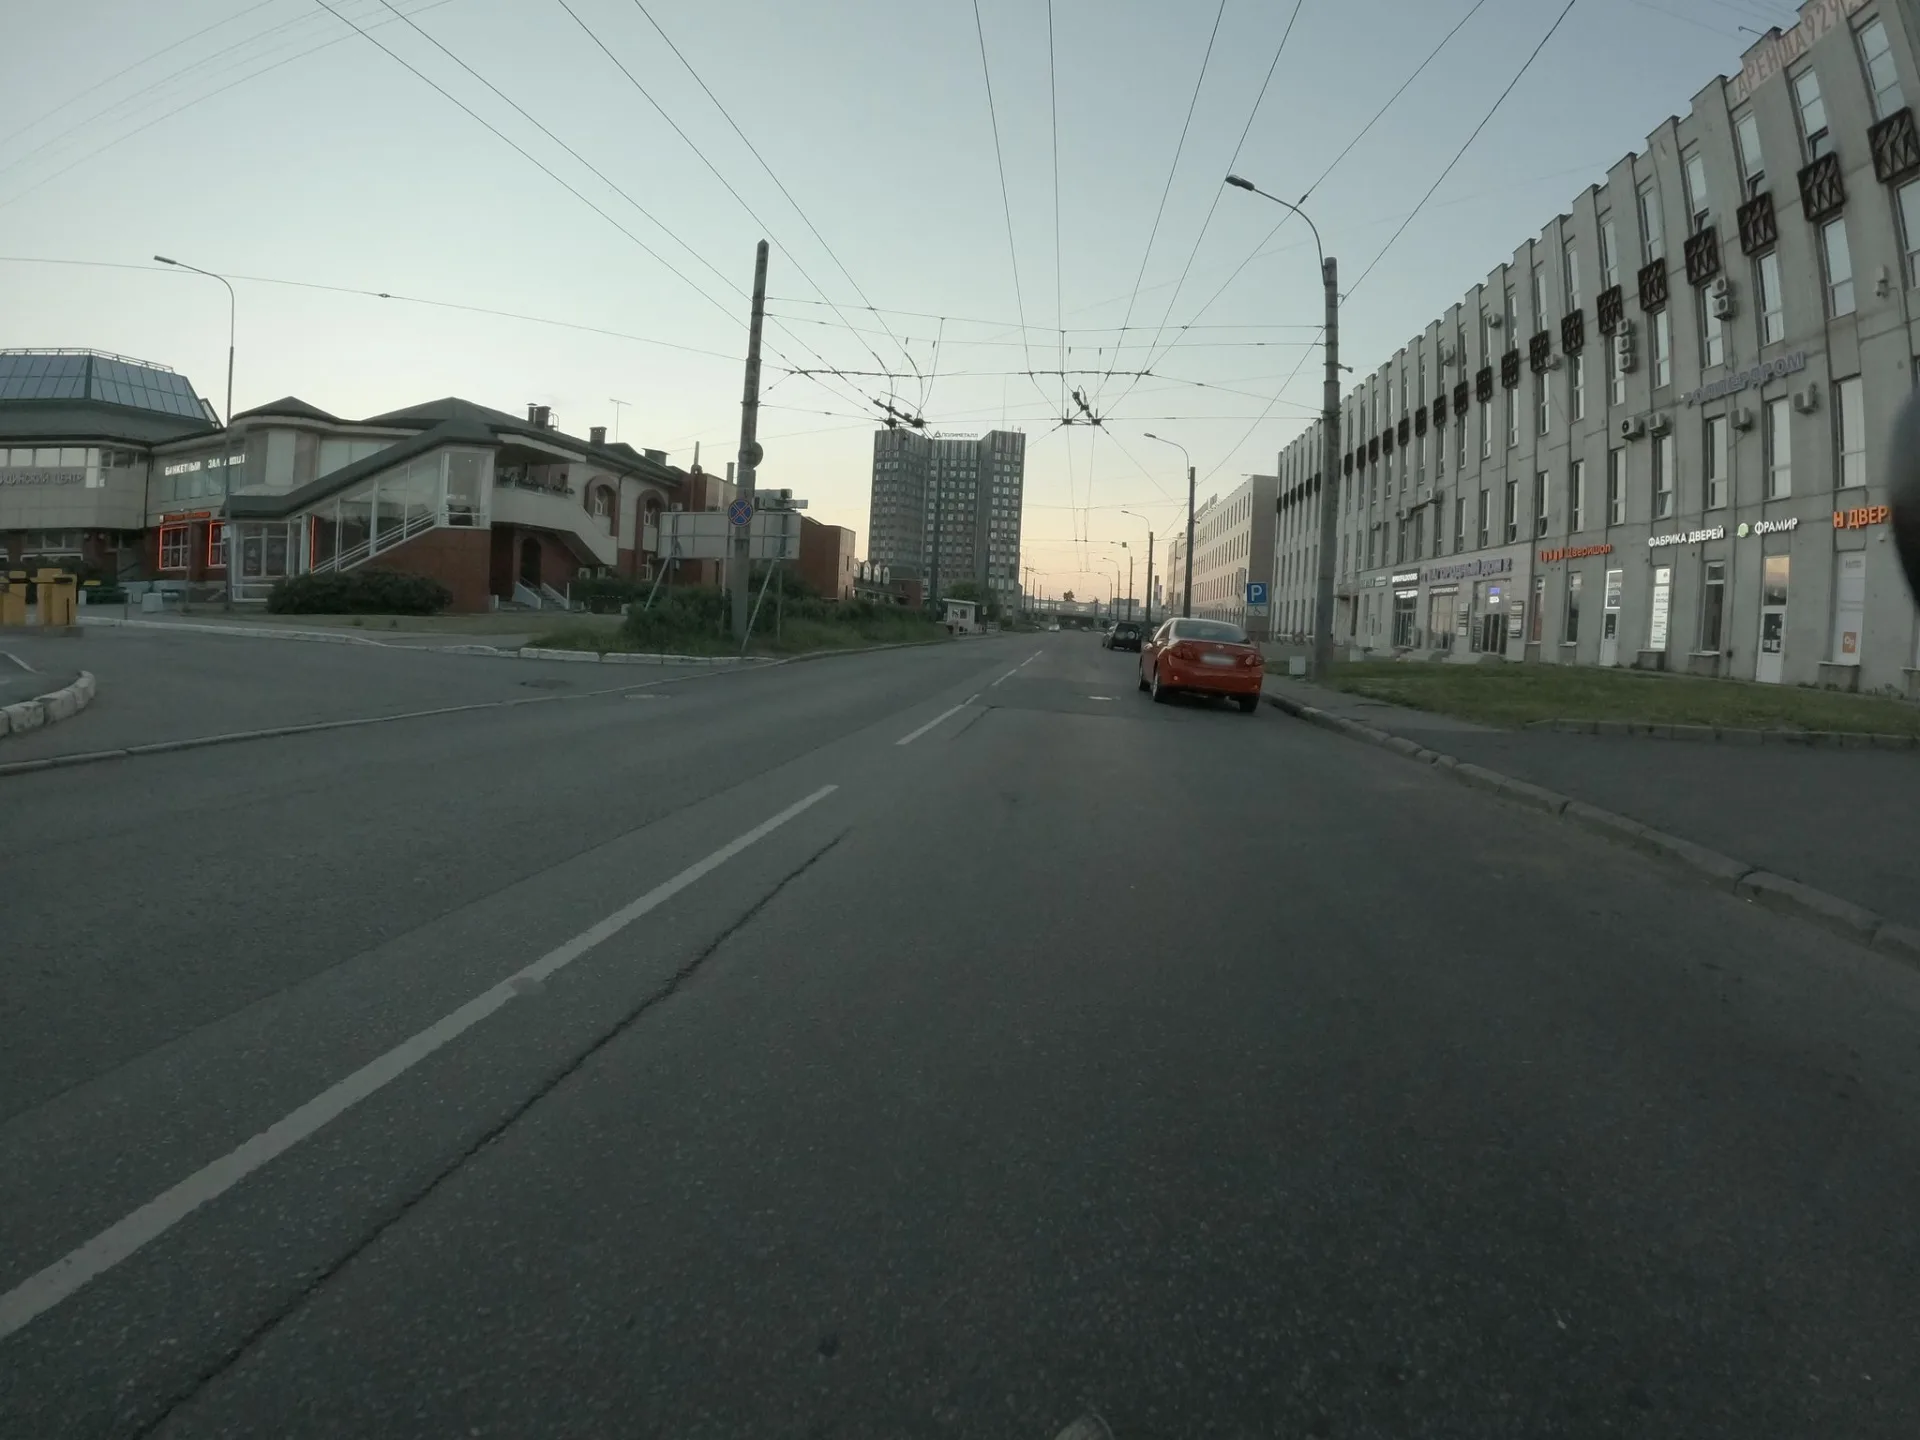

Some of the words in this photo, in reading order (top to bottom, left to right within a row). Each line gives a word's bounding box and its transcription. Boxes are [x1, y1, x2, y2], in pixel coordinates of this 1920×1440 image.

[1754, 518, 1798, 535] ФРАМИР
[1847, 505, 1892, 530] ДВЕР
[1648, 531, 1687, 547] ФАБРИКА
[1688, 527, 1724, 544] ДВЕРЕЙ
[1251, 585, 1262, 601] P
